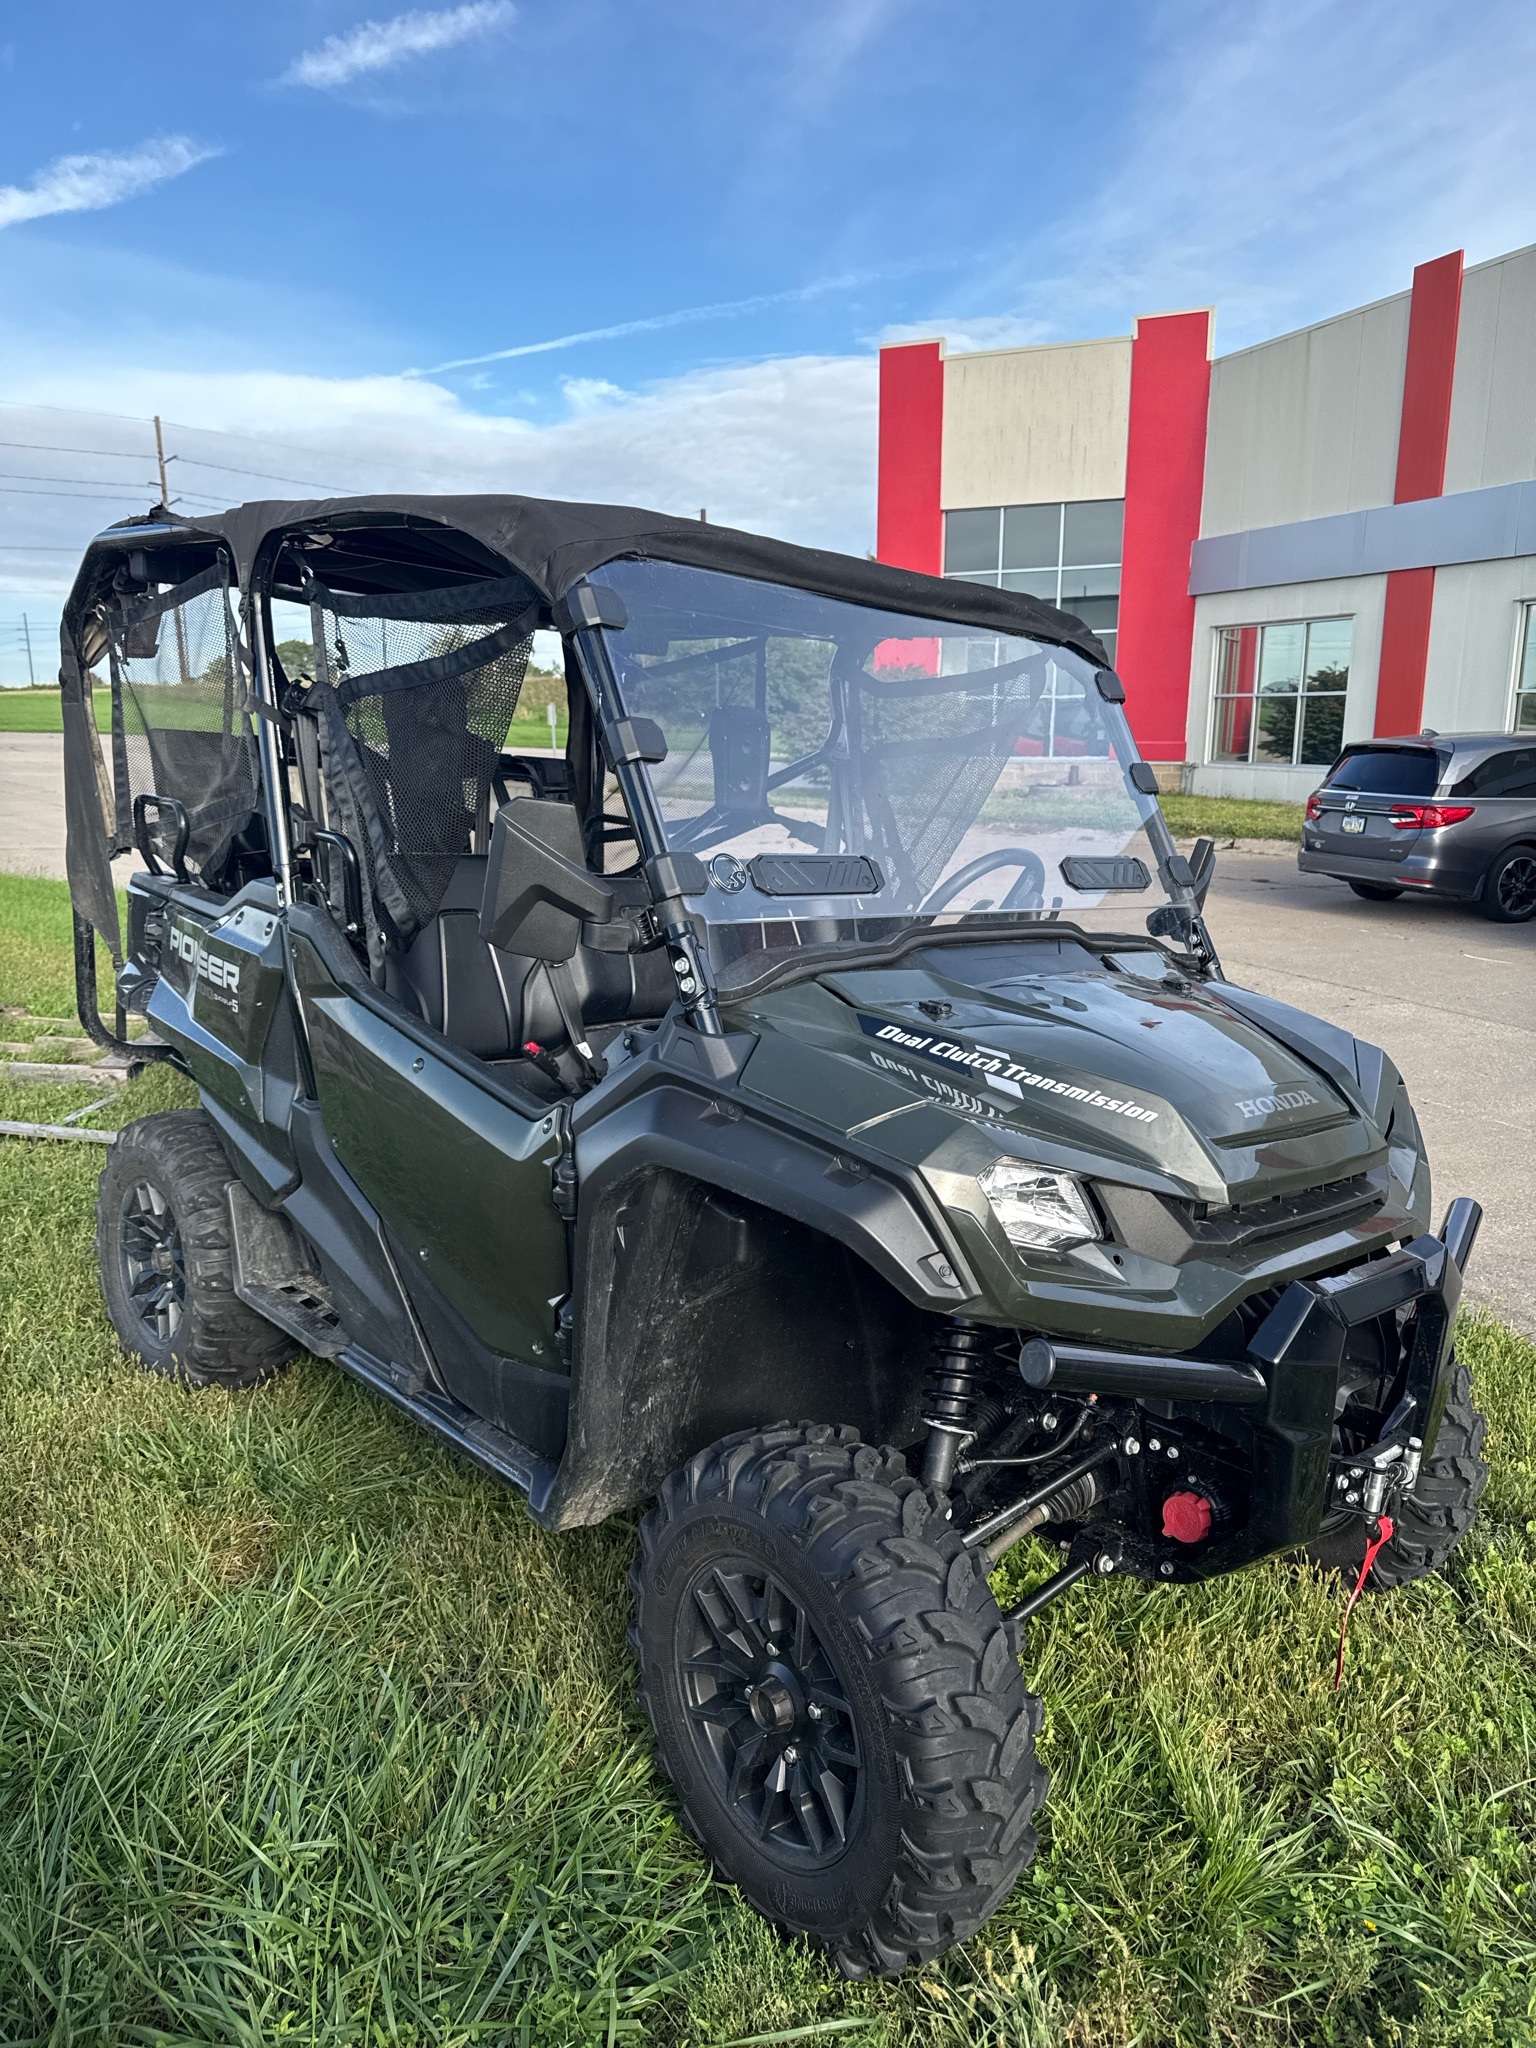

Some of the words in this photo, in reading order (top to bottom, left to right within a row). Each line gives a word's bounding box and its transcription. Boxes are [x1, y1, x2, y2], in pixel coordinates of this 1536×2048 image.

[875, 1024, 932, 1050] Dual
[928, 1042, 1003, 1073] Clutch
[999, 1063, 1159, 1123] Transmission
[1234, 1089, 1319, 1119] HONDA
